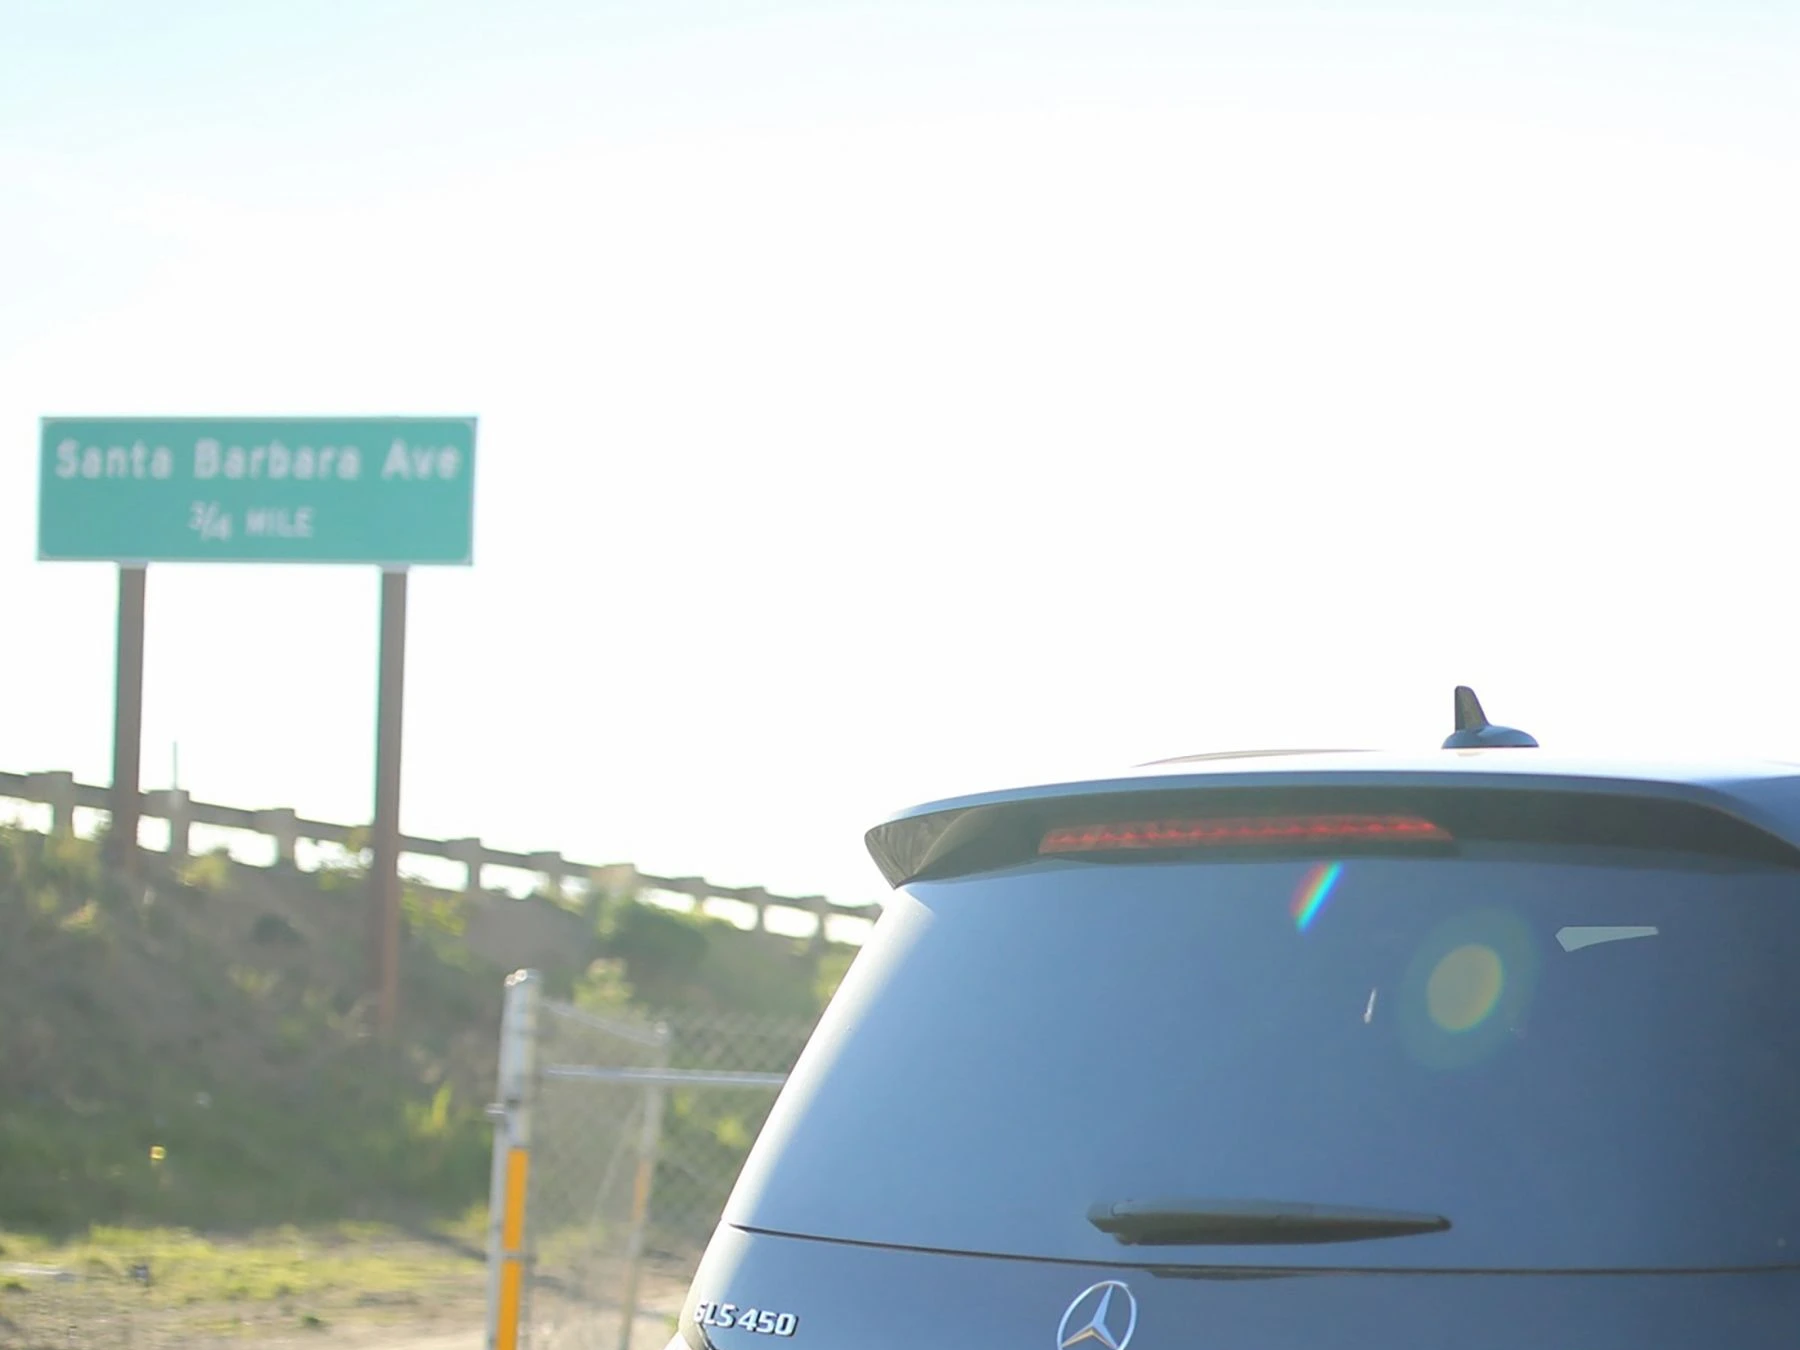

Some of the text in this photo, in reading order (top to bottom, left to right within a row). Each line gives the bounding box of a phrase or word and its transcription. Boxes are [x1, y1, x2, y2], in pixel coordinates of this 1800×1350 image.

[55, 437, 460, 481] Santa Barbara Ave
[246, 507, 313, 538] MILE
[694, 1300, 798, 1336] GLS 450
